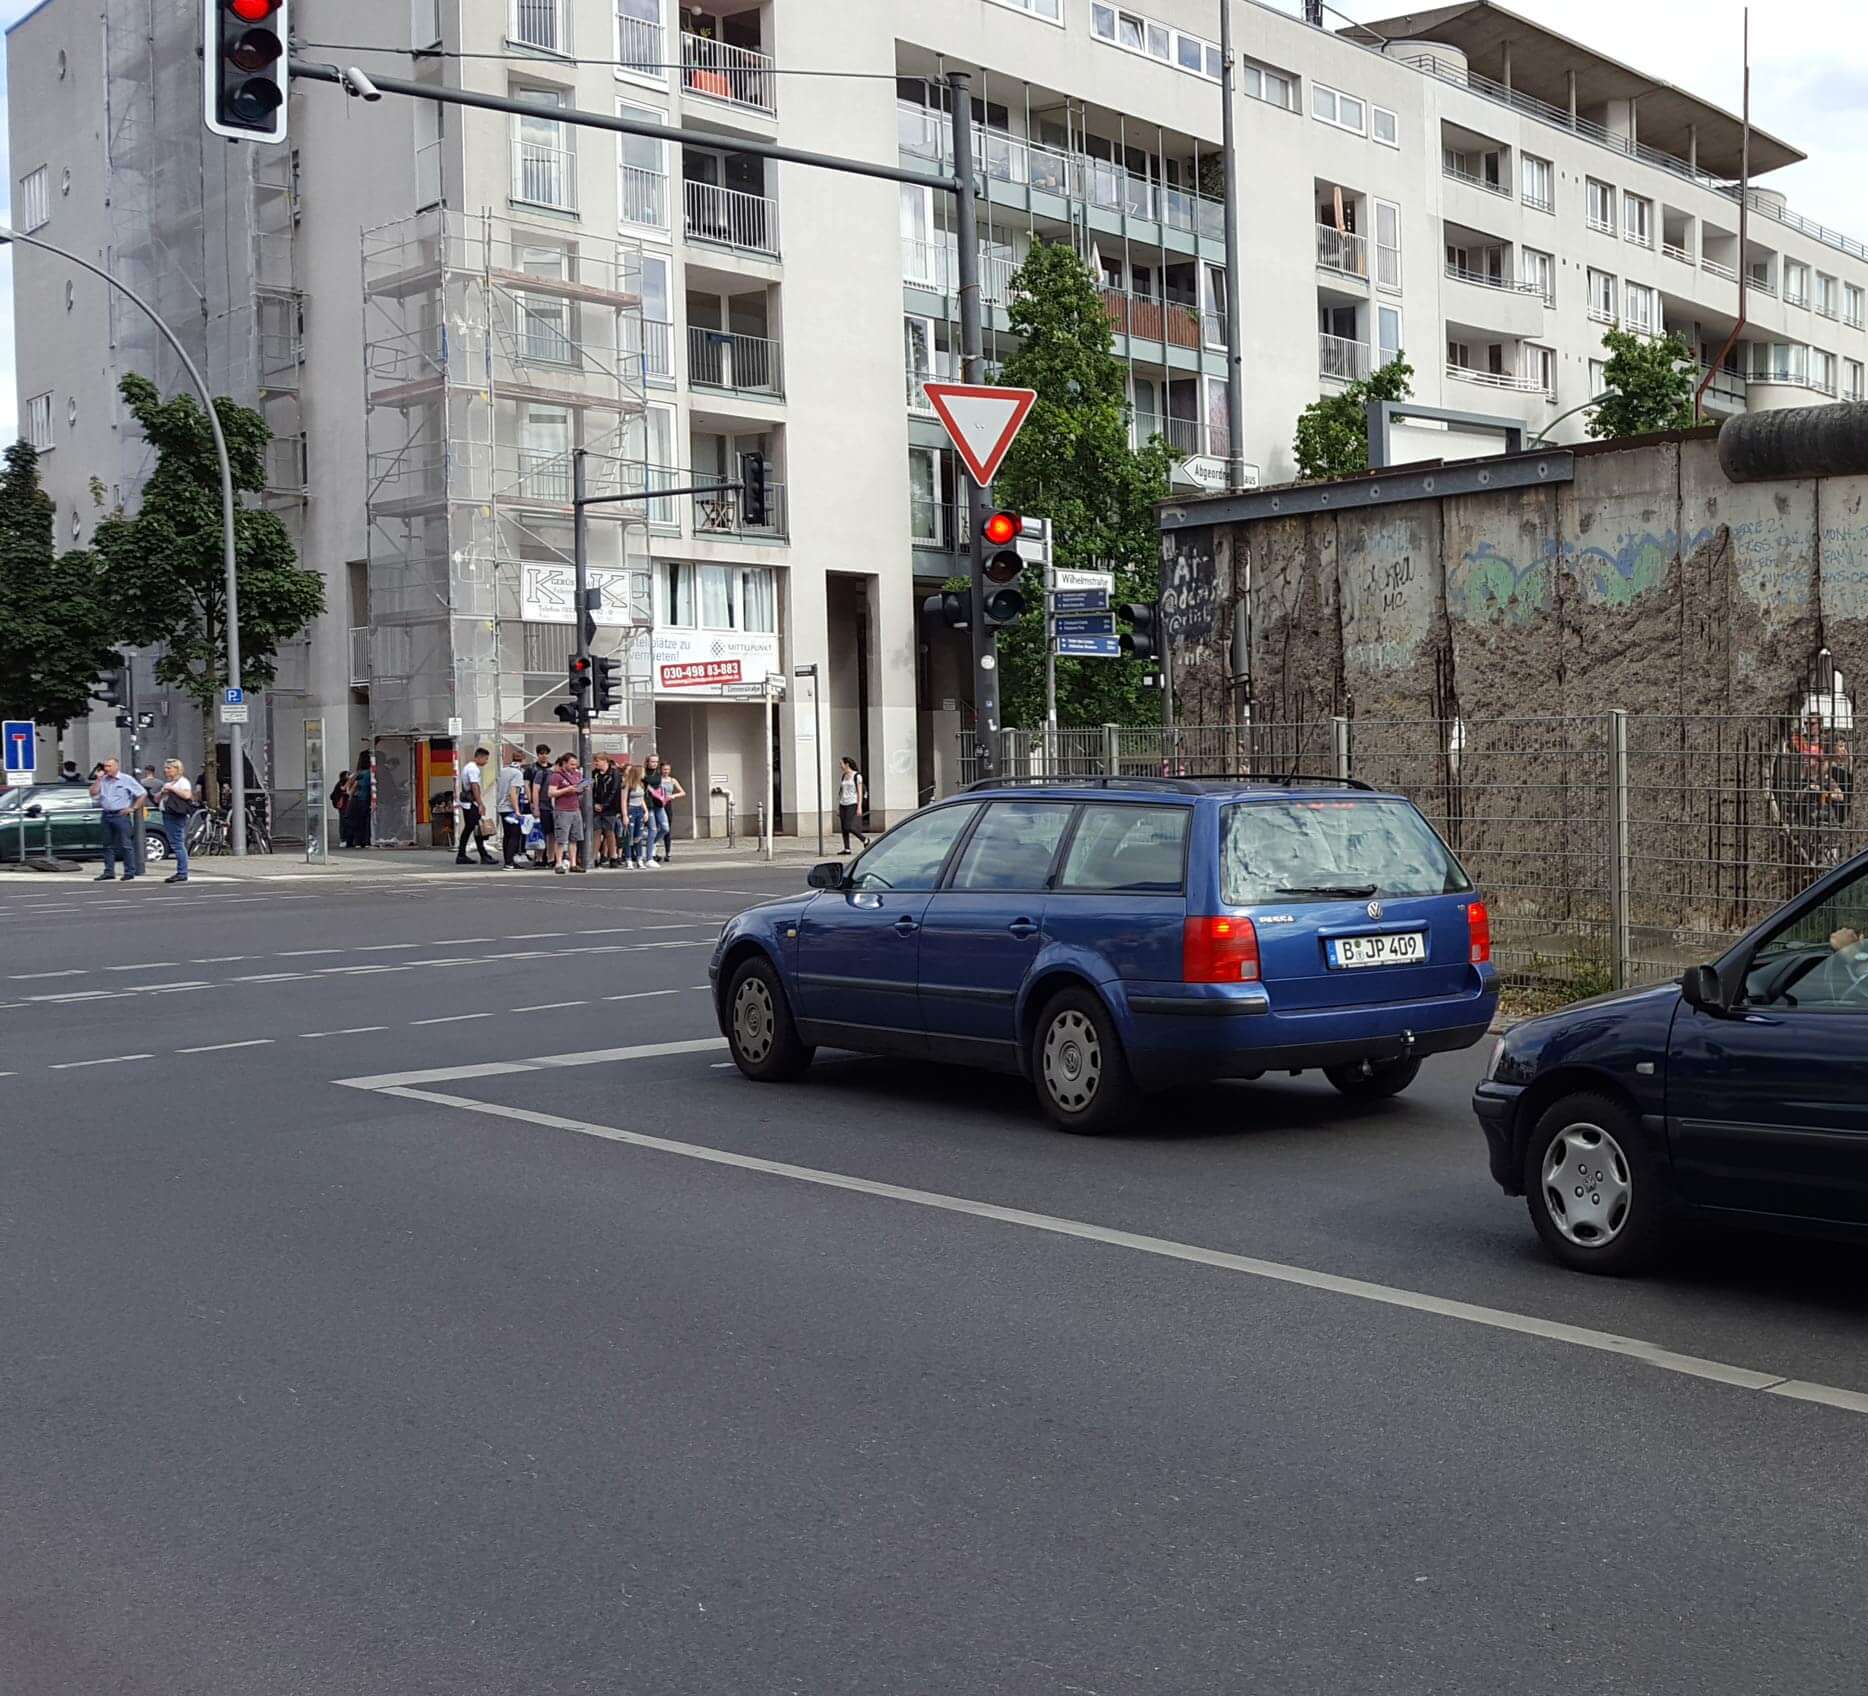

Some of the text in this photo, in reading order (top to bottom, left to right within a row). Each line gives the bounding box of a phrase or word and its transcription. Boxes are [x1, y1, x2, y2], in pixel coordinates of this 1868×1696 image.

[1061, 573, 1109, 587] Wilhelmstraße
[663, 664, 705, 679] 030-498
[707, 662, 738, 676] 83-883
[1344, 936, 1417, 961] B JP 409
